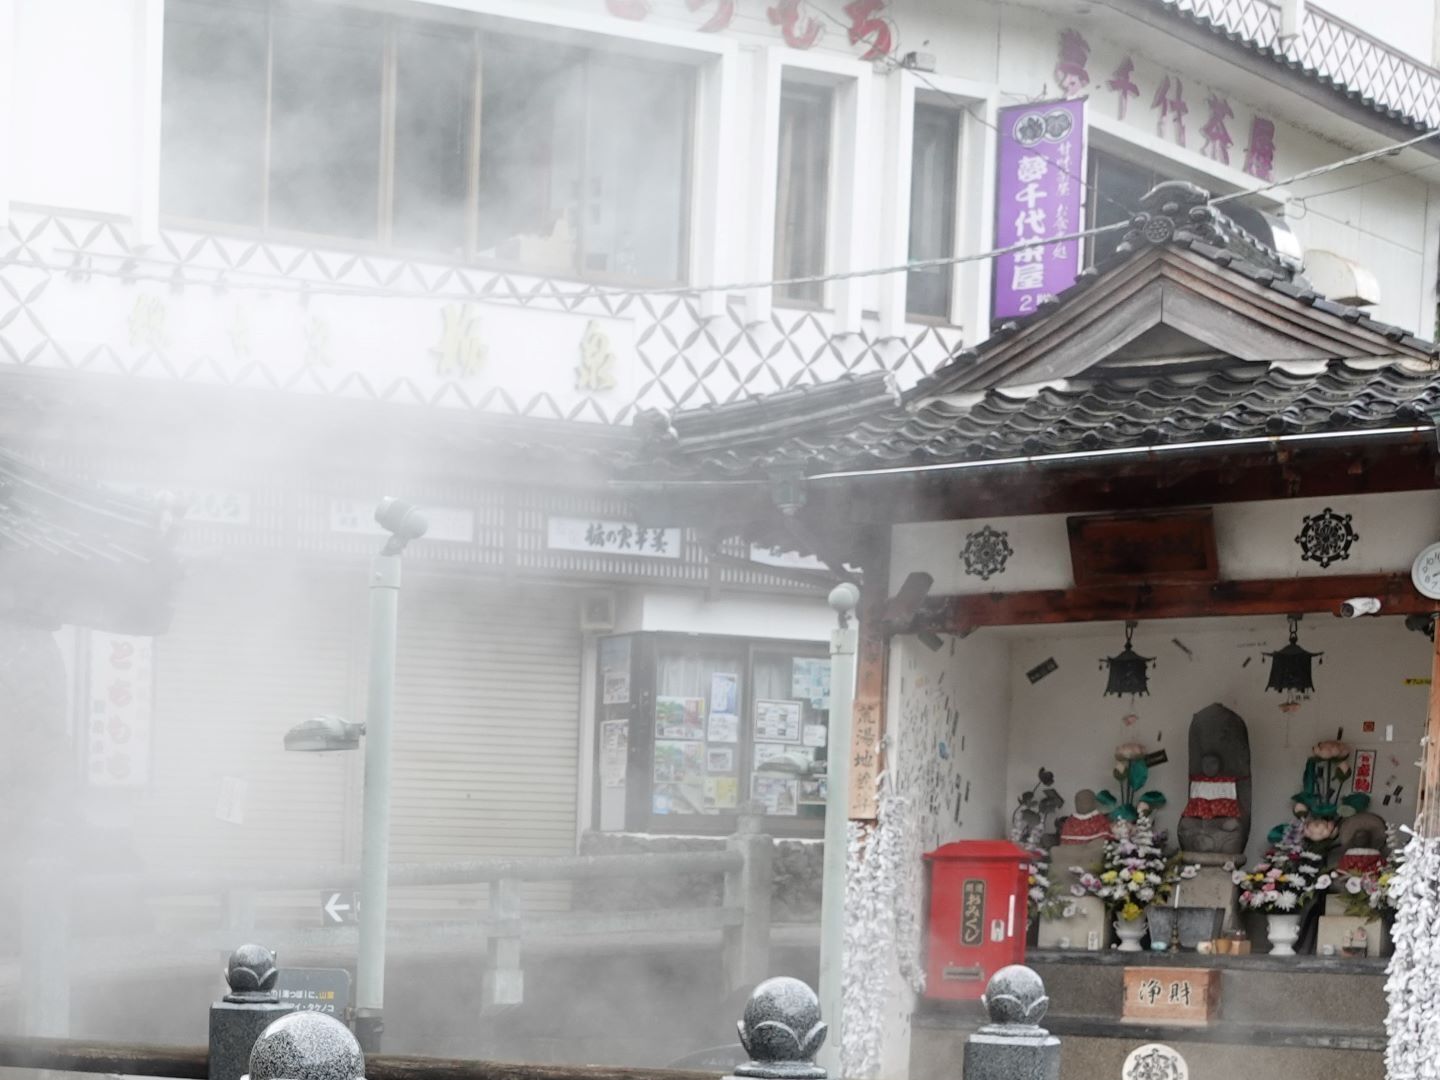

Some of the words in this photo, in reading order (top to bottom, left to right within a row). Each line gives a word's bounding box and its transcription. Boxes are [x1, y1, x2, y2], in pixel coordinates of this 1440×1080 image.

[1012, 154, 1049, 290] 夢千代茶屋
[1139, 979, 1190, 1006] 浄財
